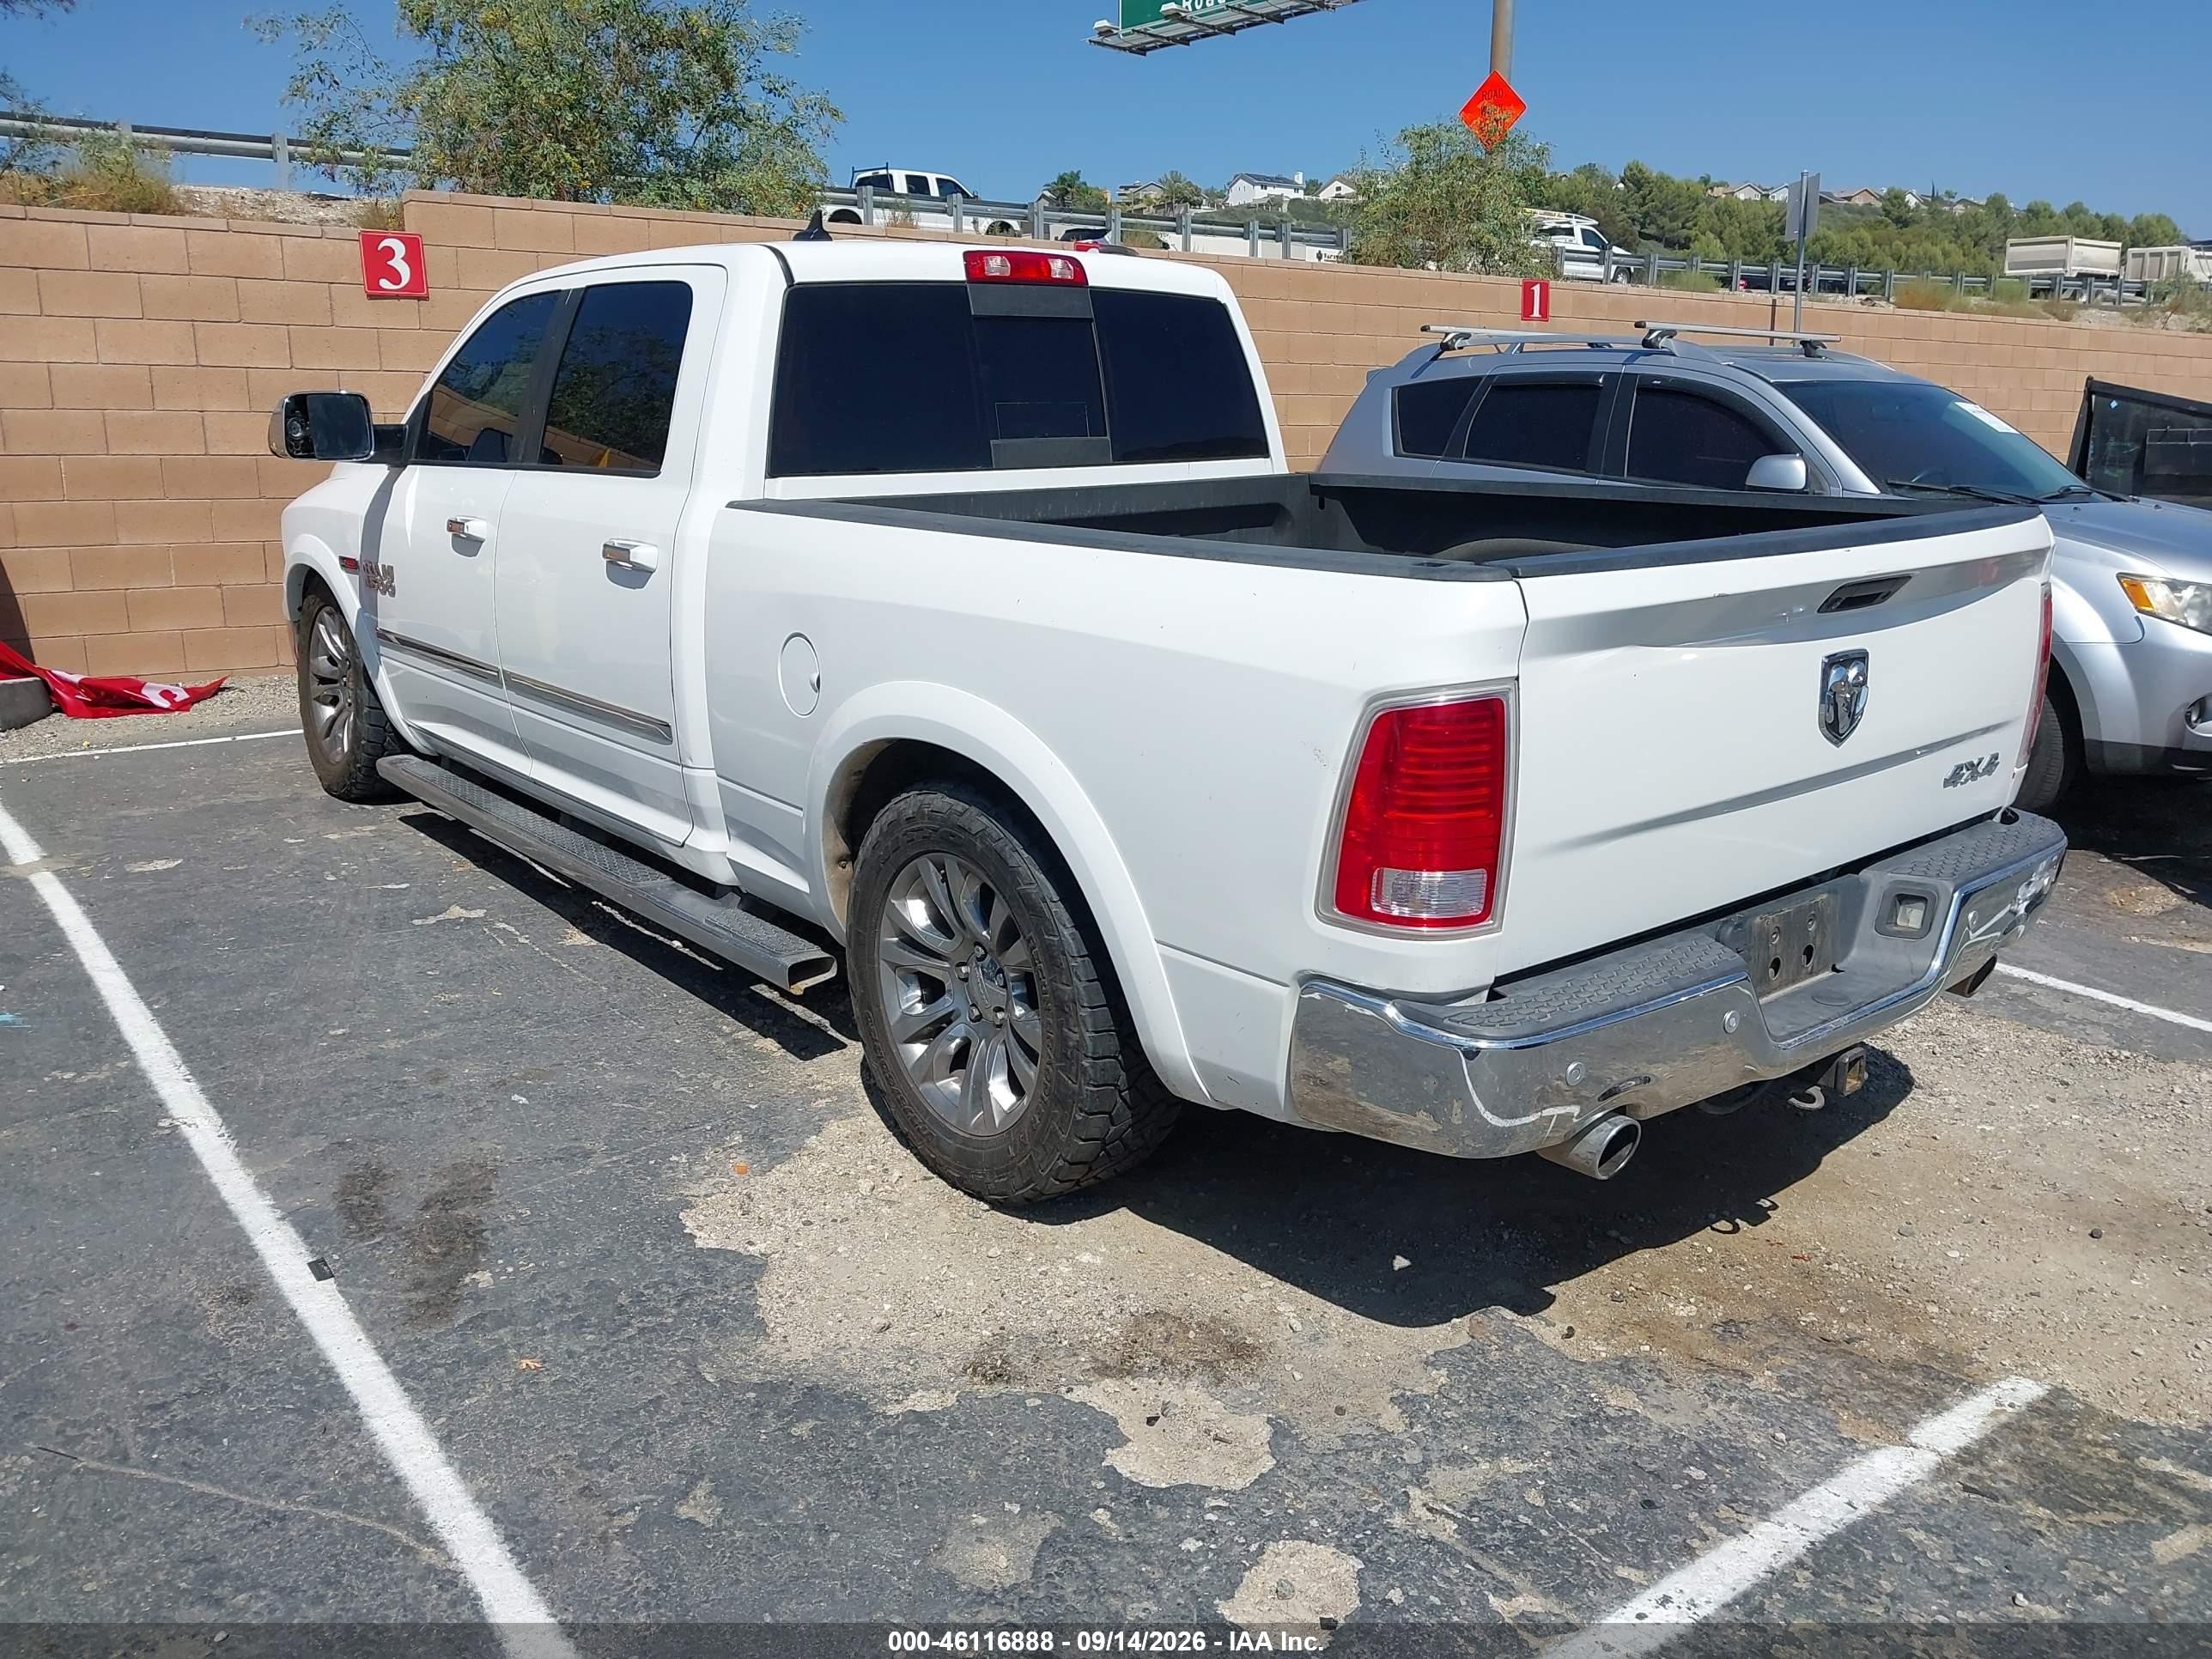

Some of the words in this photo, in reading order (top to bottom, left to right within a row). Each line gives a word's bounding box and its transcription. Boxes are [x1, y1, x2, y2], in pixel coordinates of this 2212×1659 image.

[1182, 0, 1226, 12] Roa
[1482, 88, 1504, 100] ROAD
[377, 238, 410, 289] 3
[1529, 283, 1542, 318] 1
